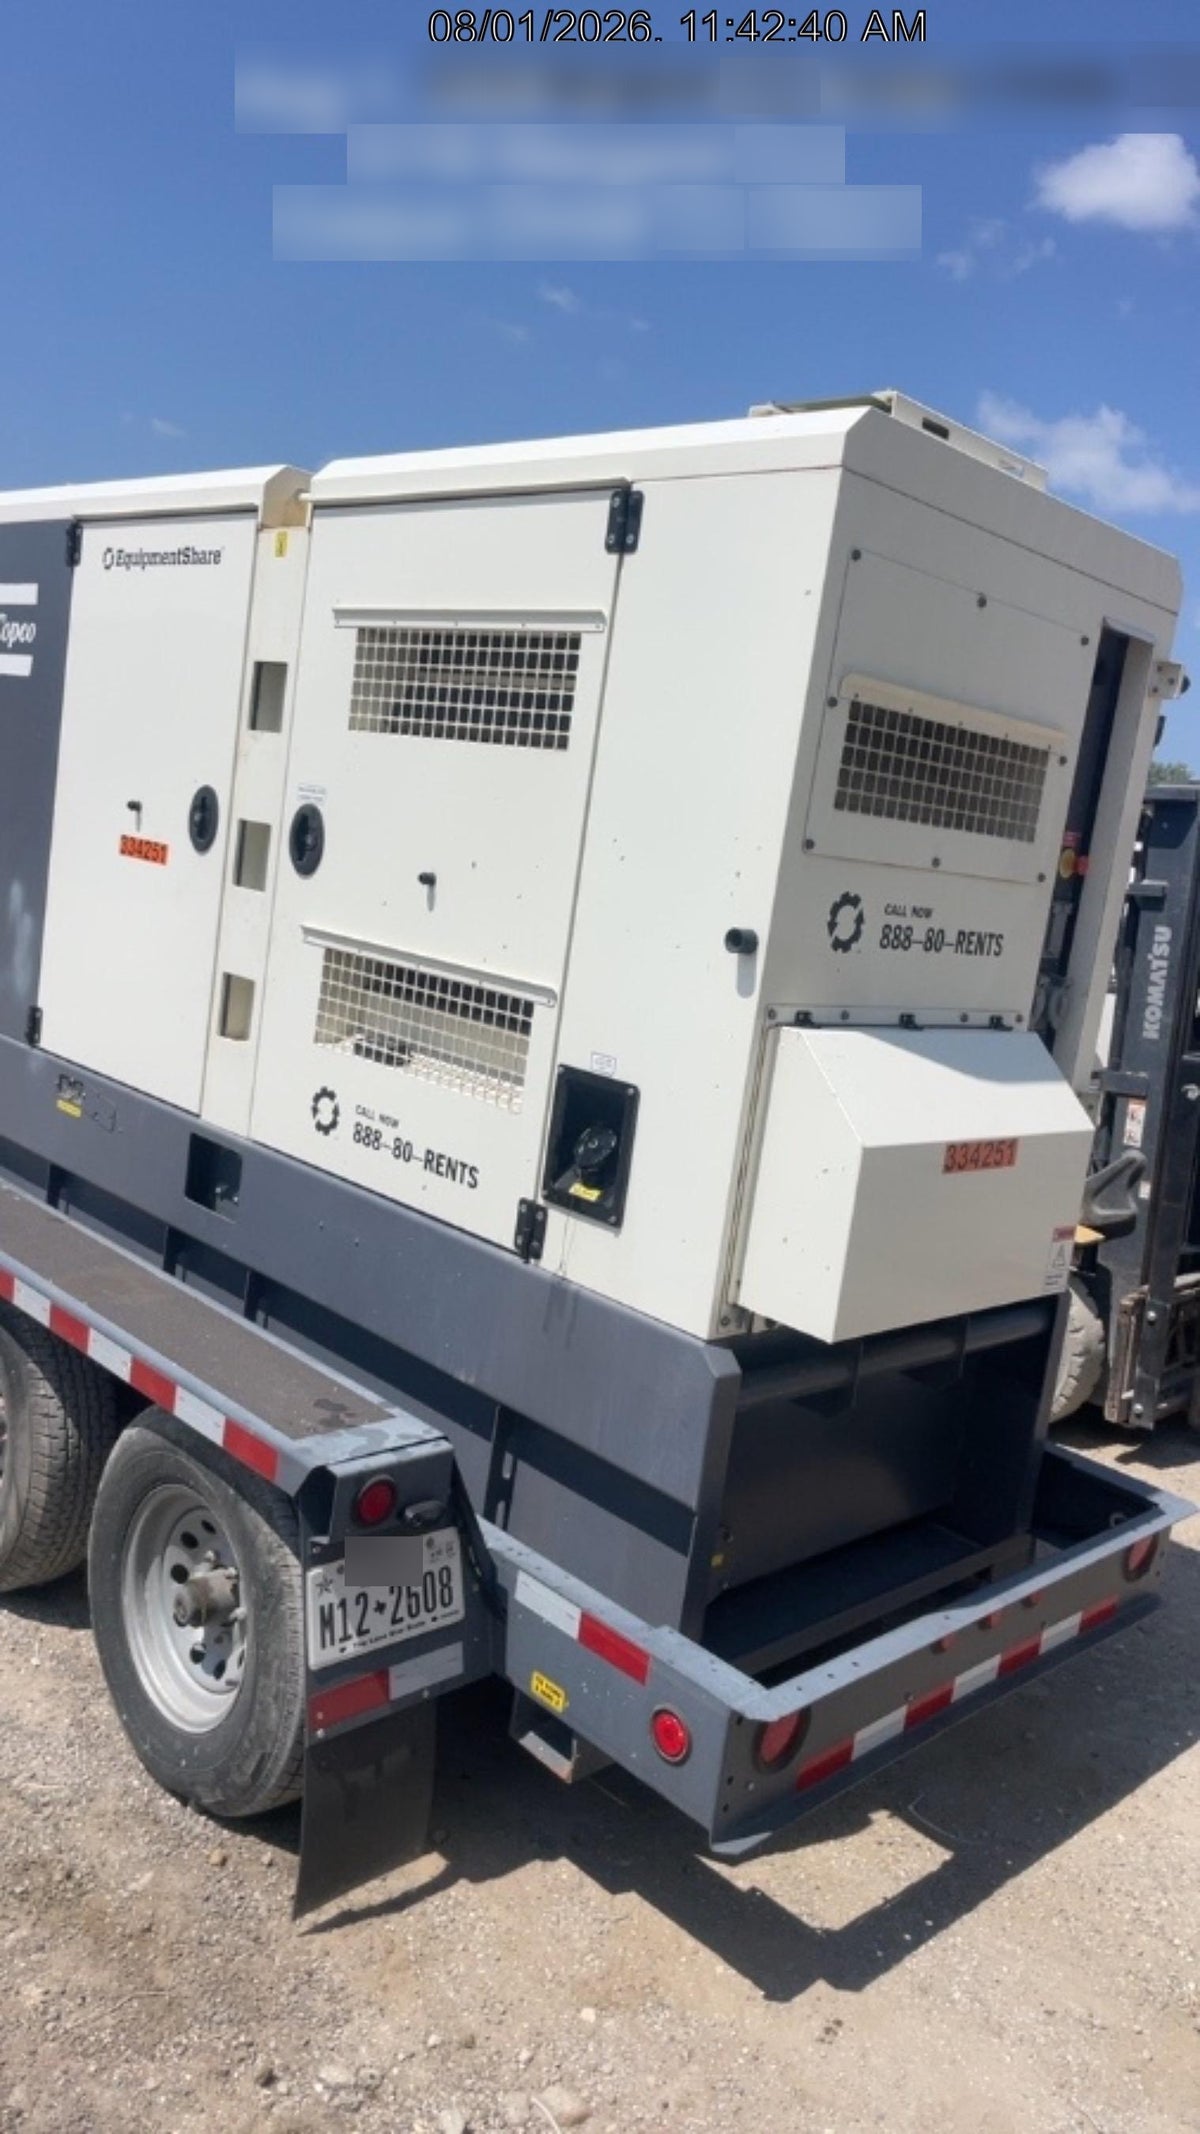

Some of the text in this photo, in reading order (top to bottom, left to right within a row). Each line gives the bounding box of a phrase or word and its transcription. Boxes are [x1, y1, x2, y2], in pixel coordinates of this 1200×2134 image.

[115, 545, 221, 571] EquipmentShare
[120, 834, 168, 865] 334251
[884, 903, 933, 918] CALL NOW
[880, 924, 1004, 956] 888-80-RENTS
[1142, 926, 1172, 1039] KOMATSU
[355, 1104, 399, 1128] CALL NOW
[353, 1121, 480, 1189] 888-80-RENTS
[943, 1139, 1018, 1173] 334251
